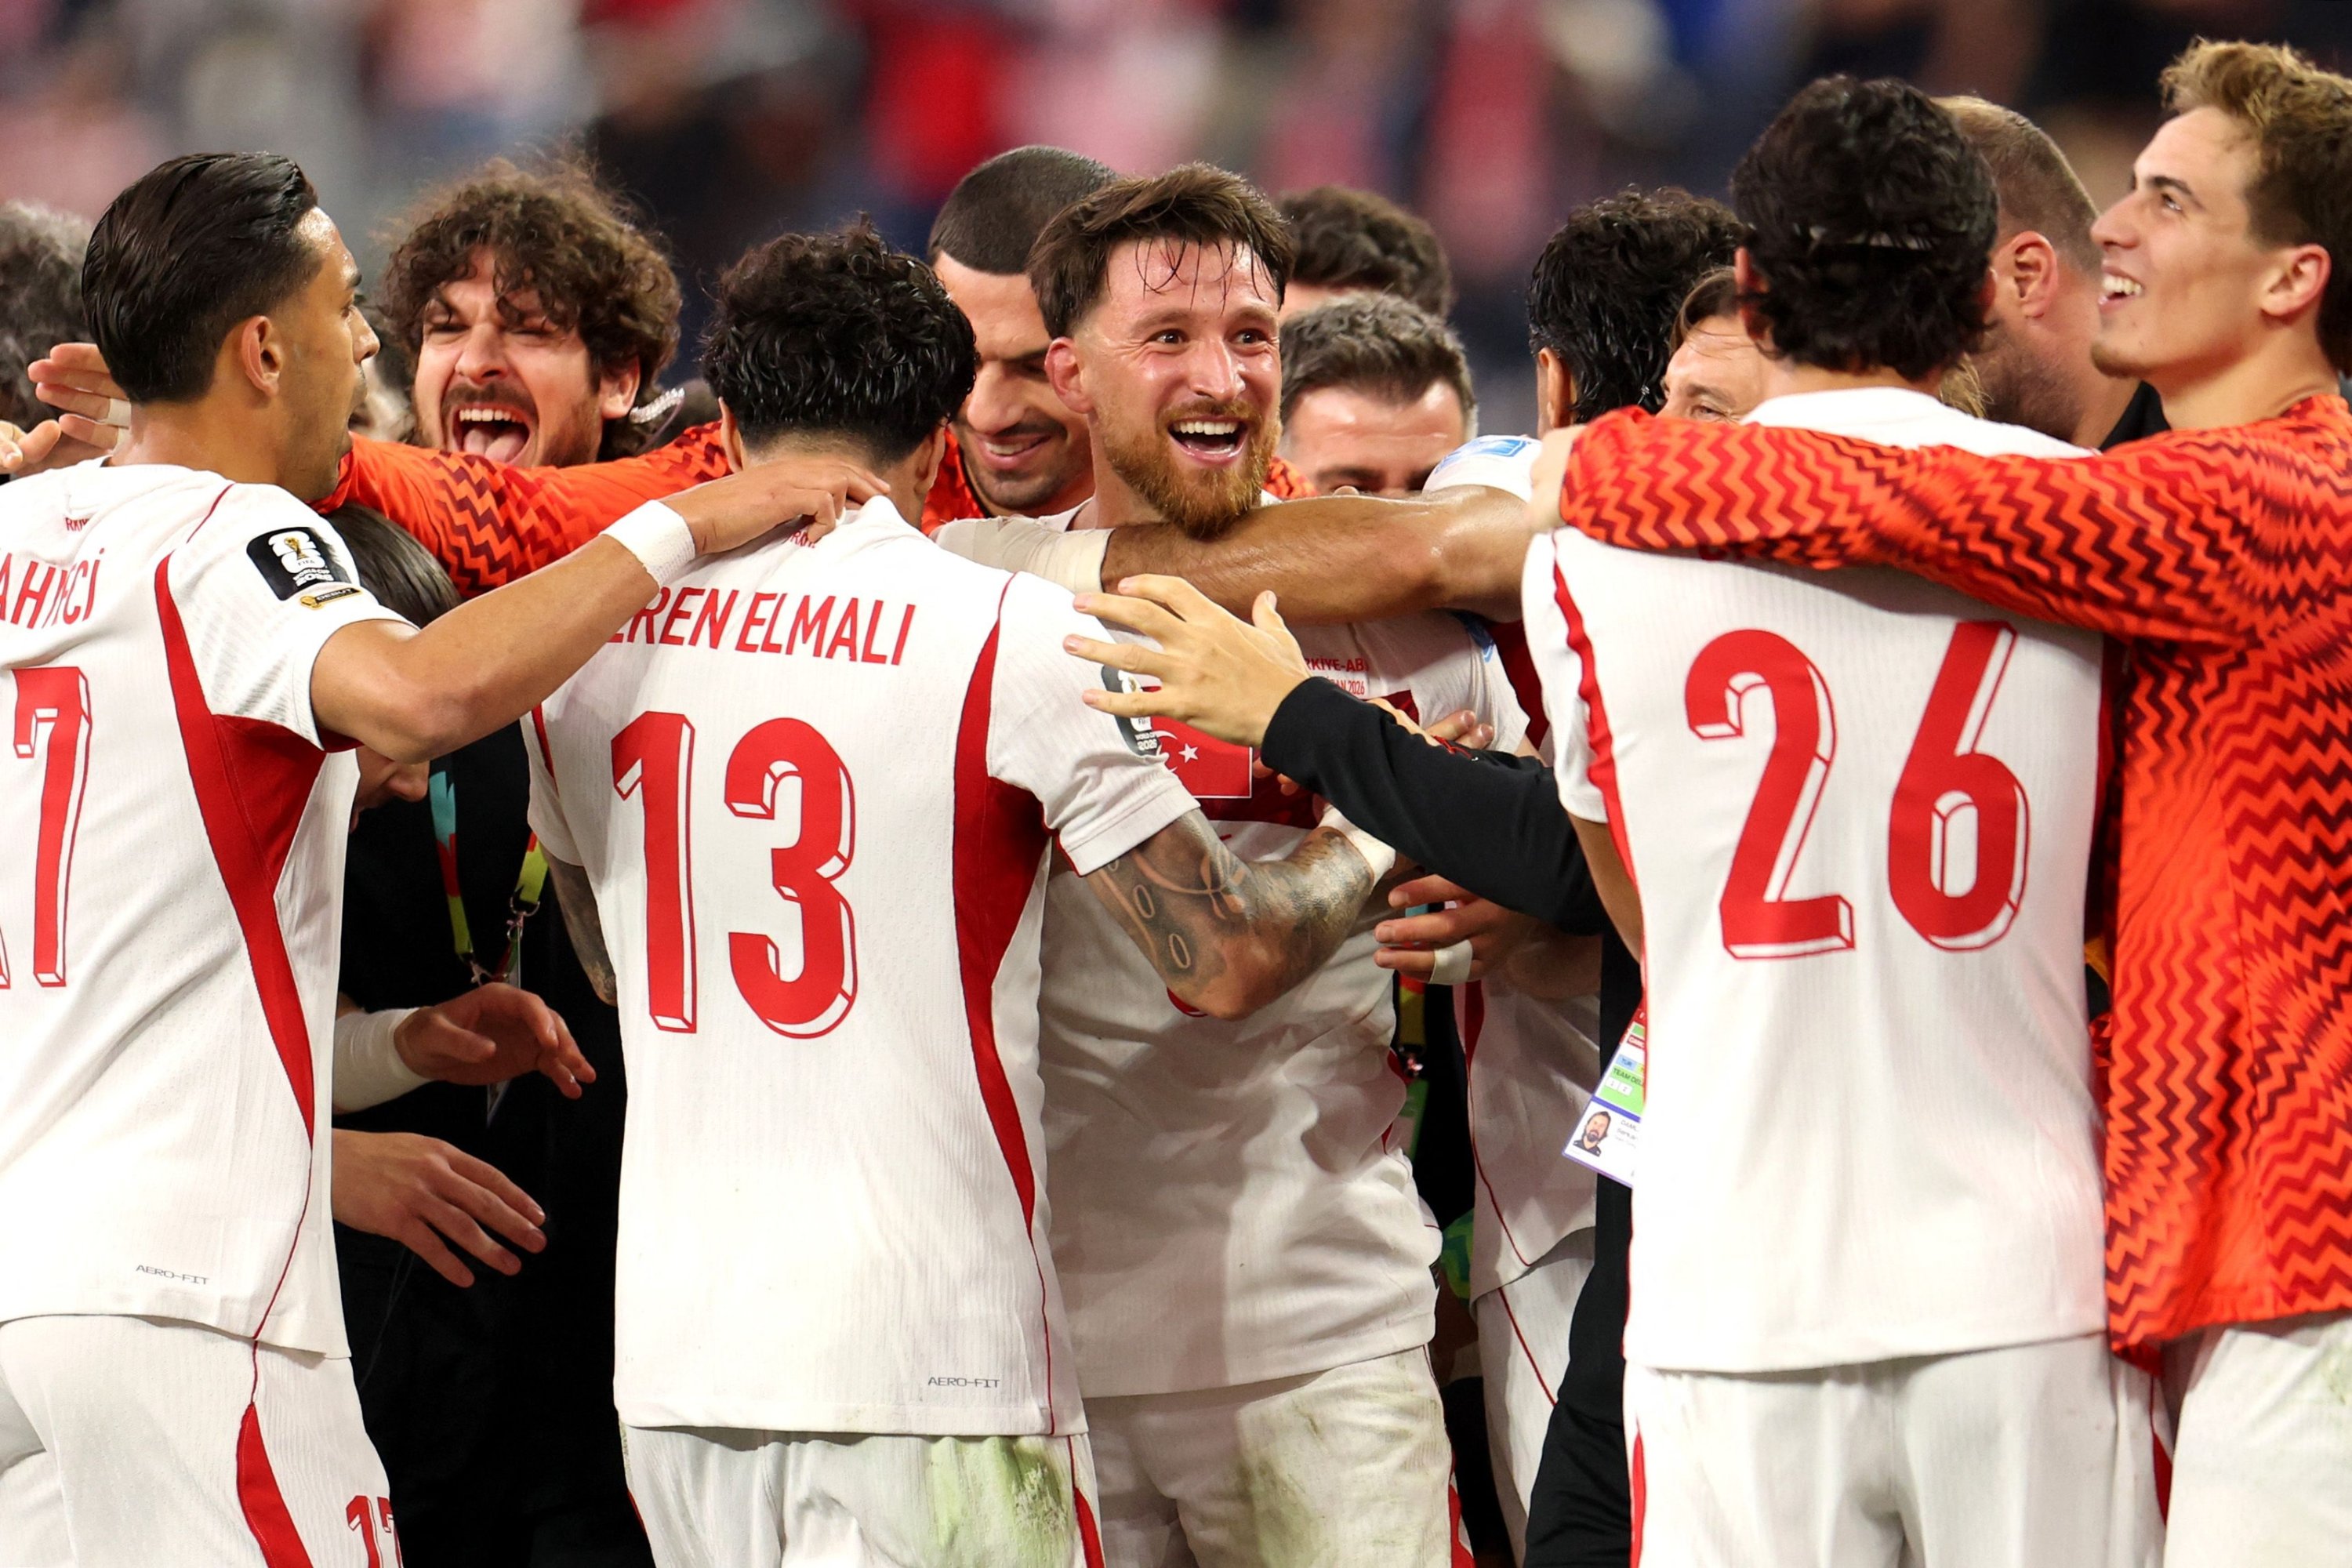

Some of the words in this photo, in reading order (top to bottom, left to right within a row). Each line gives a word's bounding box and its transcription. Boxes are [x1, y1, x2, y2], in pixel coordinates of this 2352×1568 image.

[606, 586, 740, 650] REN
[735, 592, 916, 666] ELMALI
[0, 666, 92, 989] 7
[611, 711, 858, 1040] 13
[1685, 620, 2031, 960] 26
[136, 1265, 210, 1285] AERO-FIT
[927, 1377, 1000, 1388] AERO-FIT
